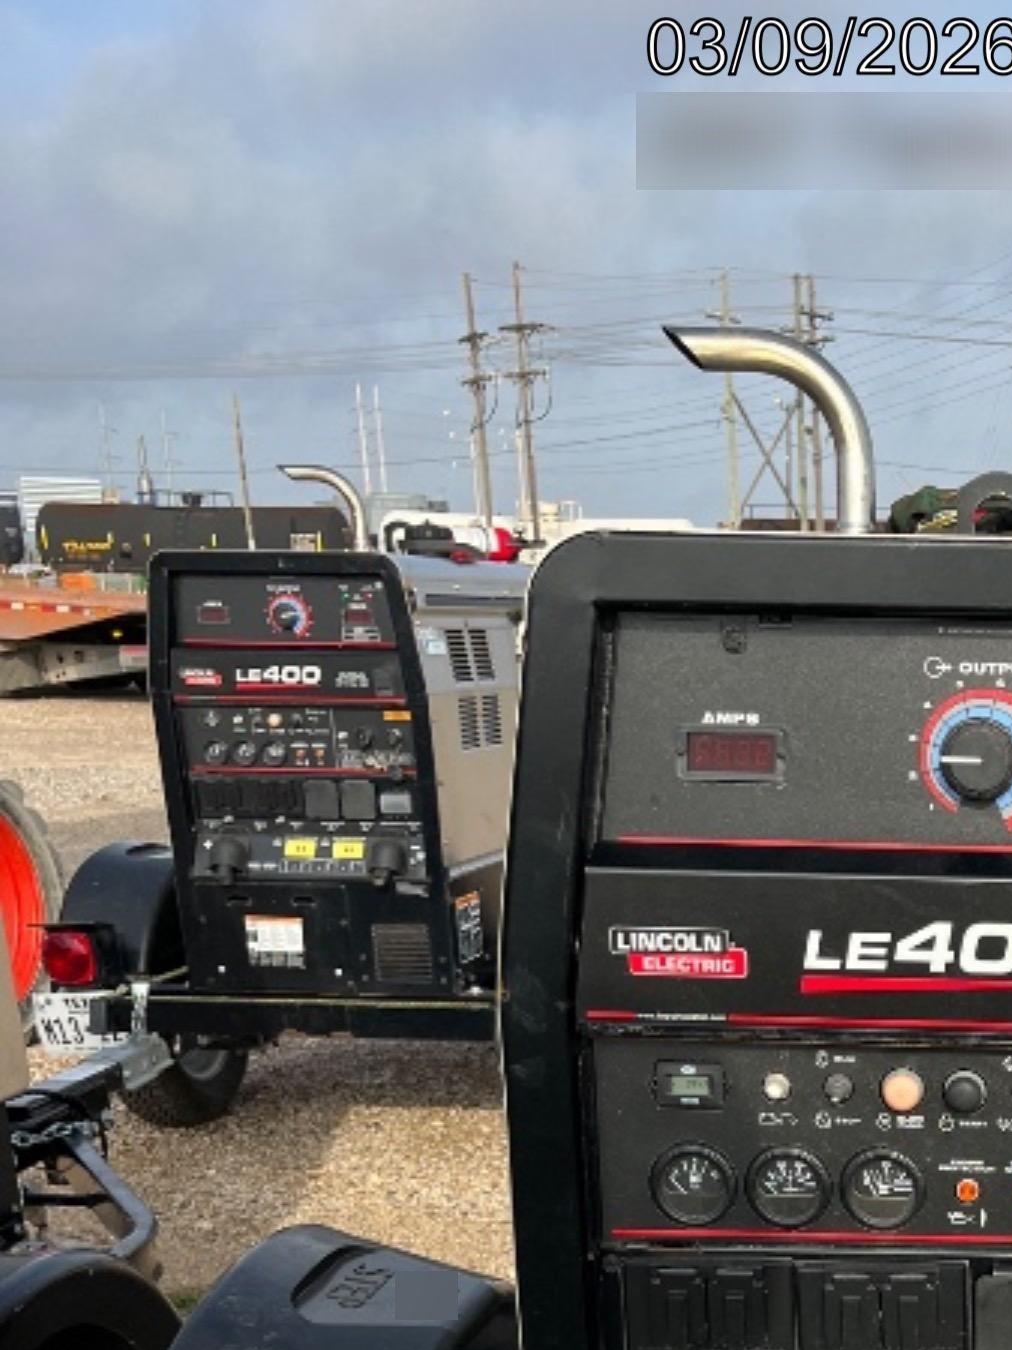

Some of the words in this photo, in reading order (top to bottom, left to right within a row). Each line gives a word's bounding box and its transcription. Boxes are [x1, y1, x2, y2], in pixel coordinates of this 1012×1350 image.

[234, 664, 323, 685] LE400
[701, 710, 760, 726] AMPS
[616, 931, 722, 953] LINCOLN
[642, 955, 736, 973] ELECTRIC
